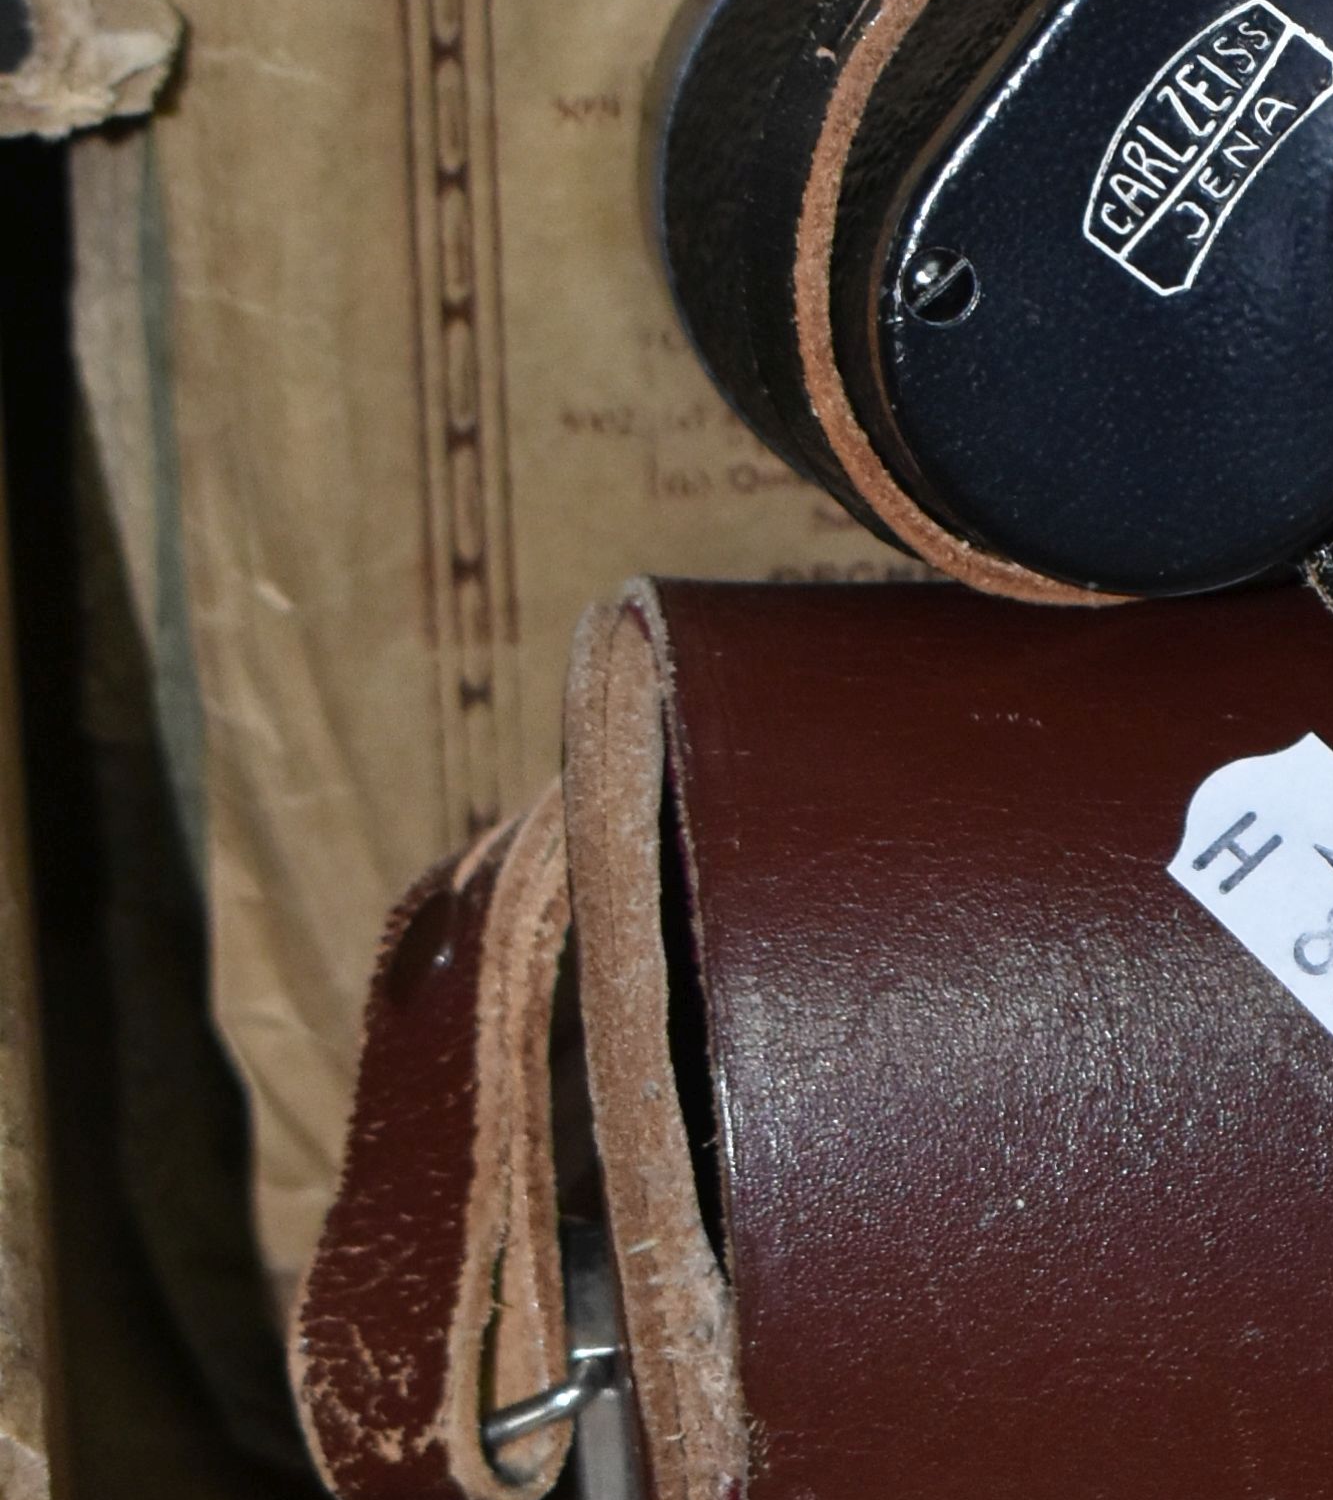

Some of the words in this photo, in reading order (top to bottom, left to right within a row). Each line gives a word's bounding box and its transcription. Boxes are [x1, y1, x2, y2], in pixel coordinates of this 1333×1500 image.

[1100, 124, 1200, 236] CARL
[1156, 20, 1272, 137] ZEISS
[1175, 96, 1298, 246] JENA
[1192, 810, 1284, 896] H
